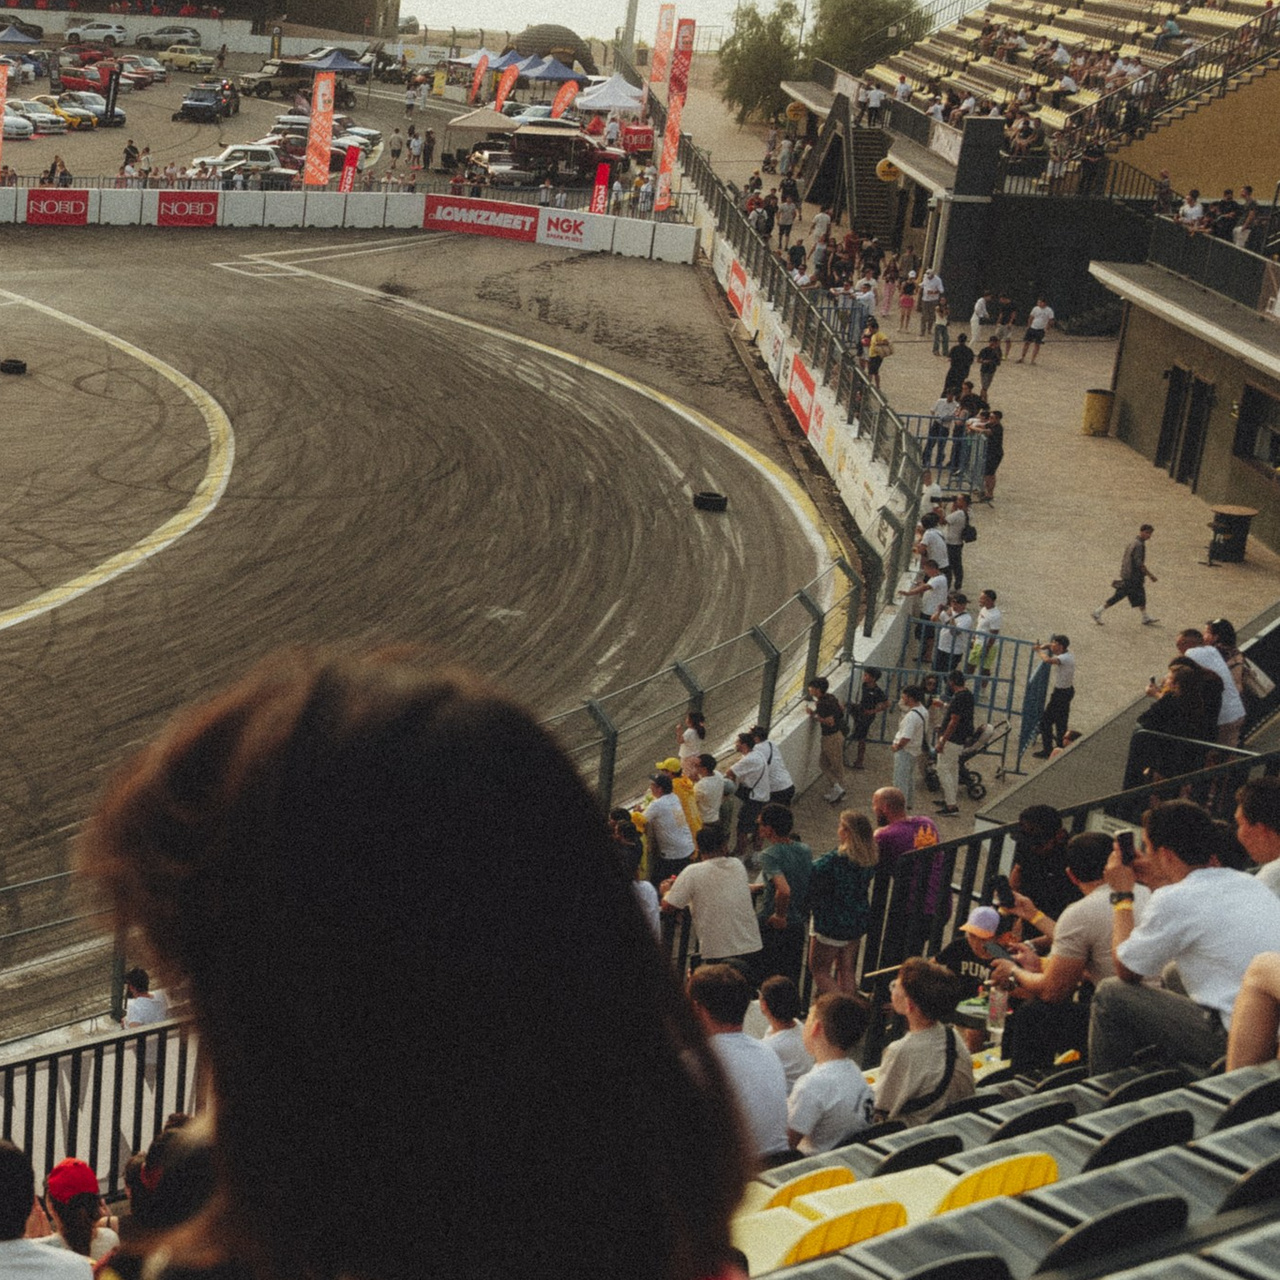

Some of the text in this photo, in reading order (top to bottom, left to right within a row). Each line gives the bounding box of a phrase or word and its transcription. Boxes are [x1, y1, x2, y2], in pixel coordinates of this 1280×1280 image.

[29, 200, 86, 215] NORD
[160, 201, 216, 216] NORD
[435, 205, 535, 231] LOWKZMEET
[546, 216, 585, 236] NGK
[960, 961, 991, 981] PUM
